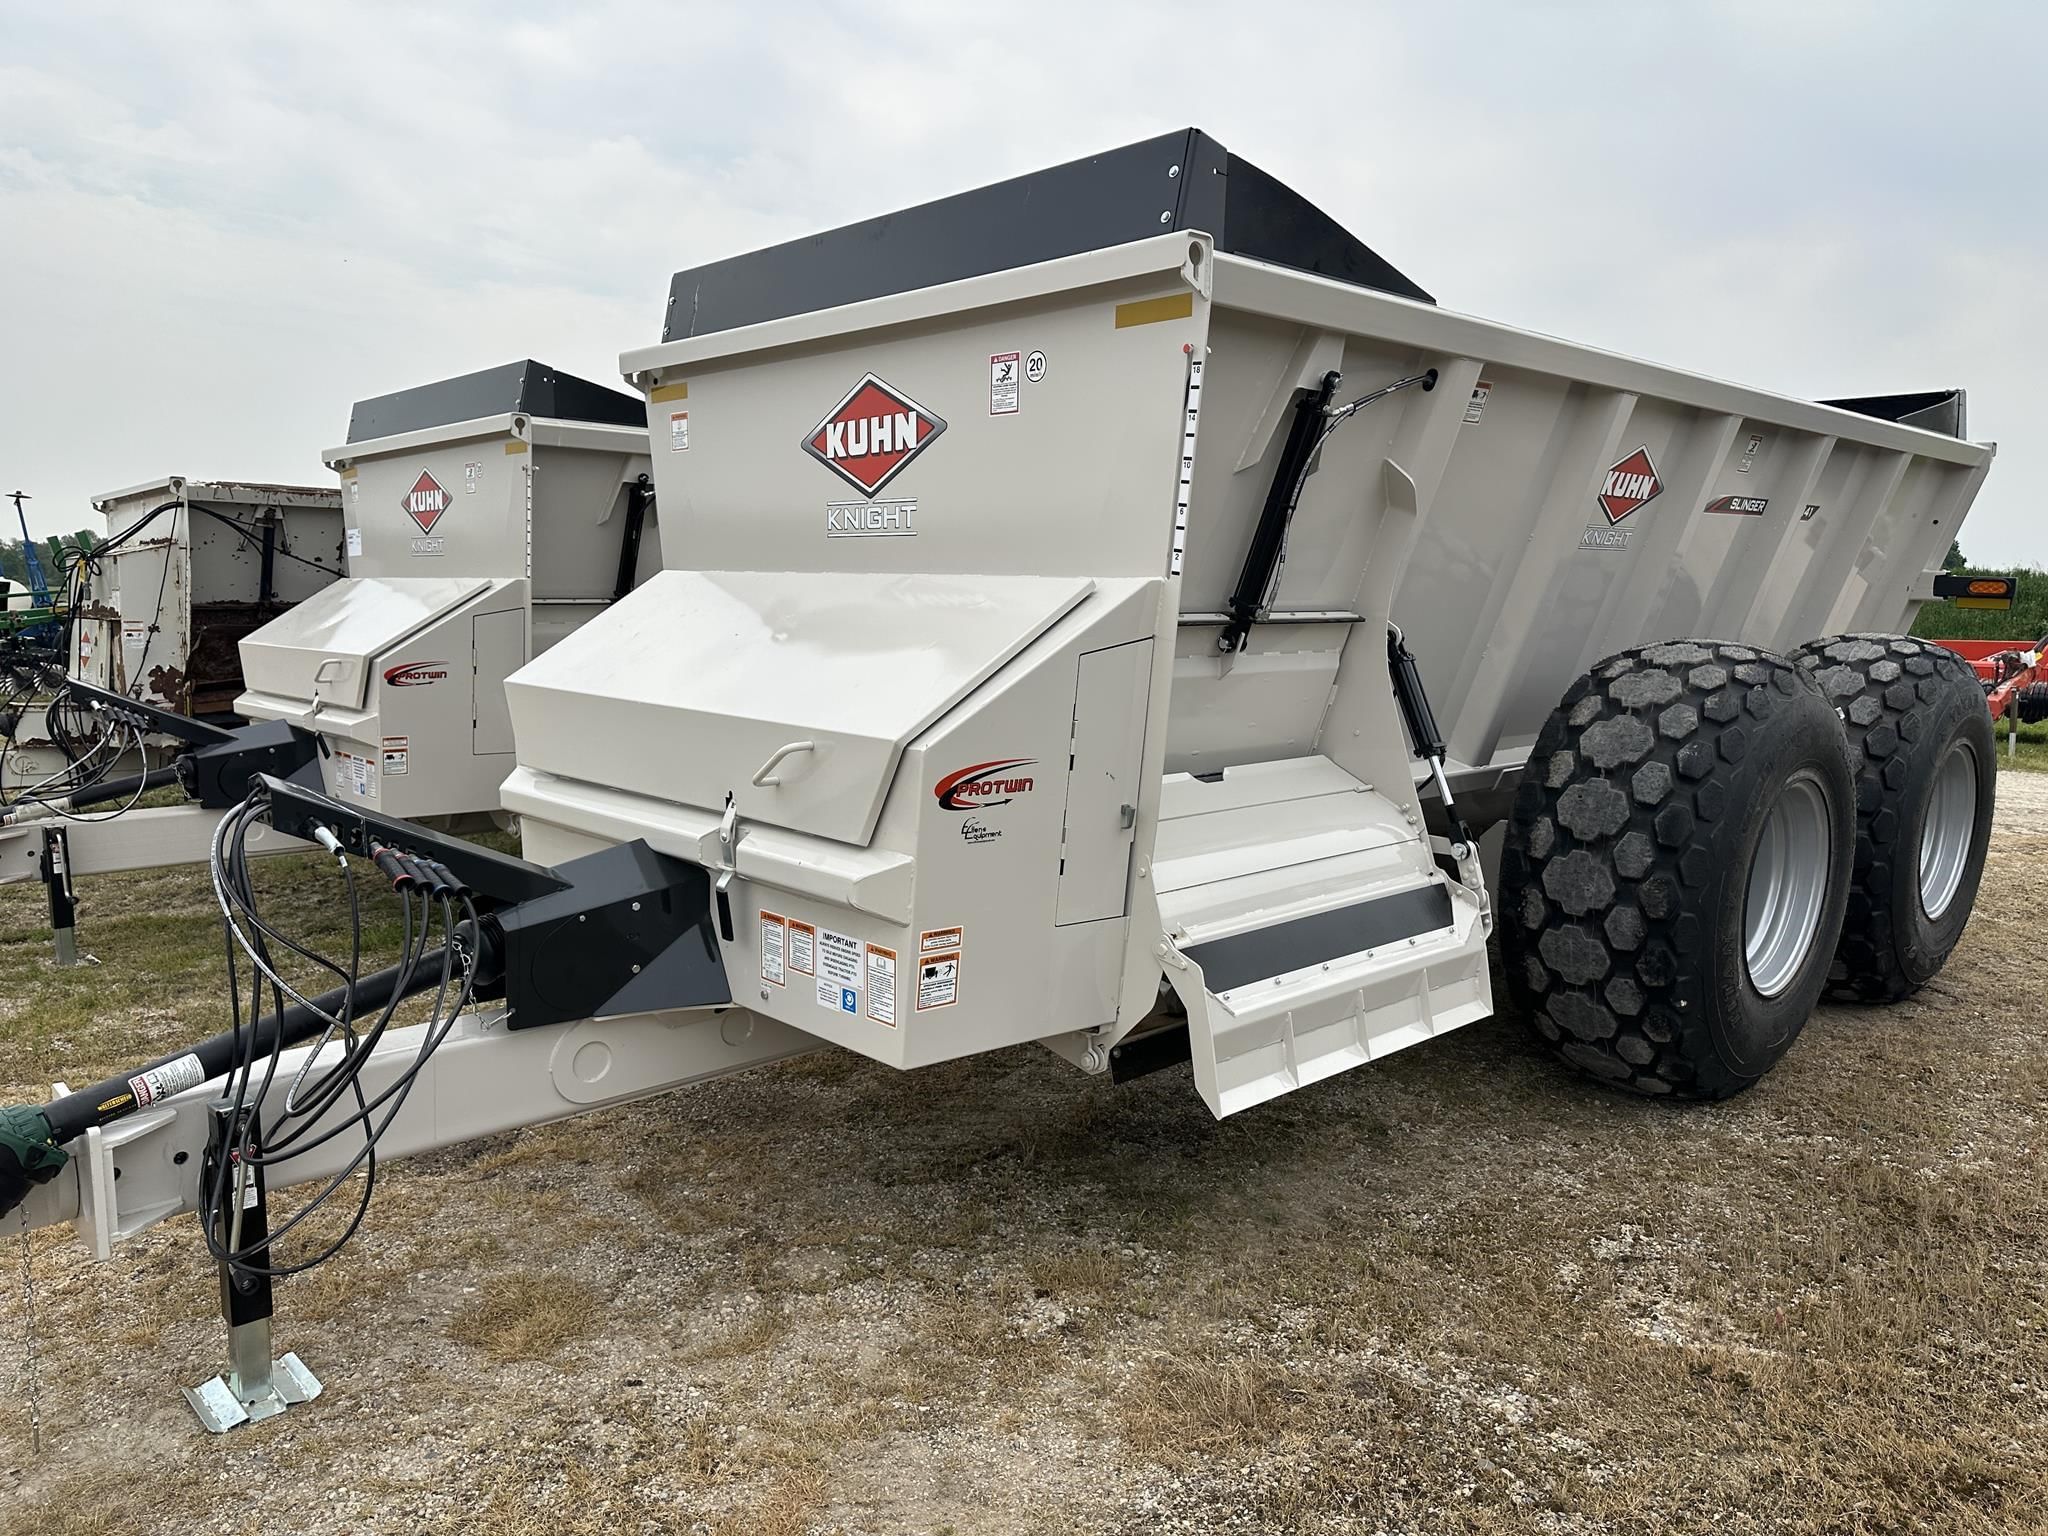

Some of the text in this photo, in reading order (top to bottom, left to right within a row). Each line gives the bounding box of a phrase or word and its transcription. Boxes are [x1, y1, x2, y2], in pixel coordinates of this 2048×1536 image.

[1029, 357, 1043, 371] 20
[1192, 366, 1201, 374] 18
[1188, 414, 1196, 422] 14
[825, 411, 917, 460] KUHN
[1600, 470, 1655, 500] KUHN
[410, 489, 443, 513] KUHN
[1730, 498, 1766, 512] SLINGER
[827, 505, 917, 531] KNIGHT
[1179, 508, 1184, 516] 6
[412, 540, 444, 552] KNIGHT
[1581, 530, 1633, 546] KNIGHT
[398, 671, 447, 680] PROTWIN
[956, 777, 1033, 798] PROTWIN
[823, 933, 857, 949] IMPORTANT
[134, 1077, 150, 1106] DANGER
